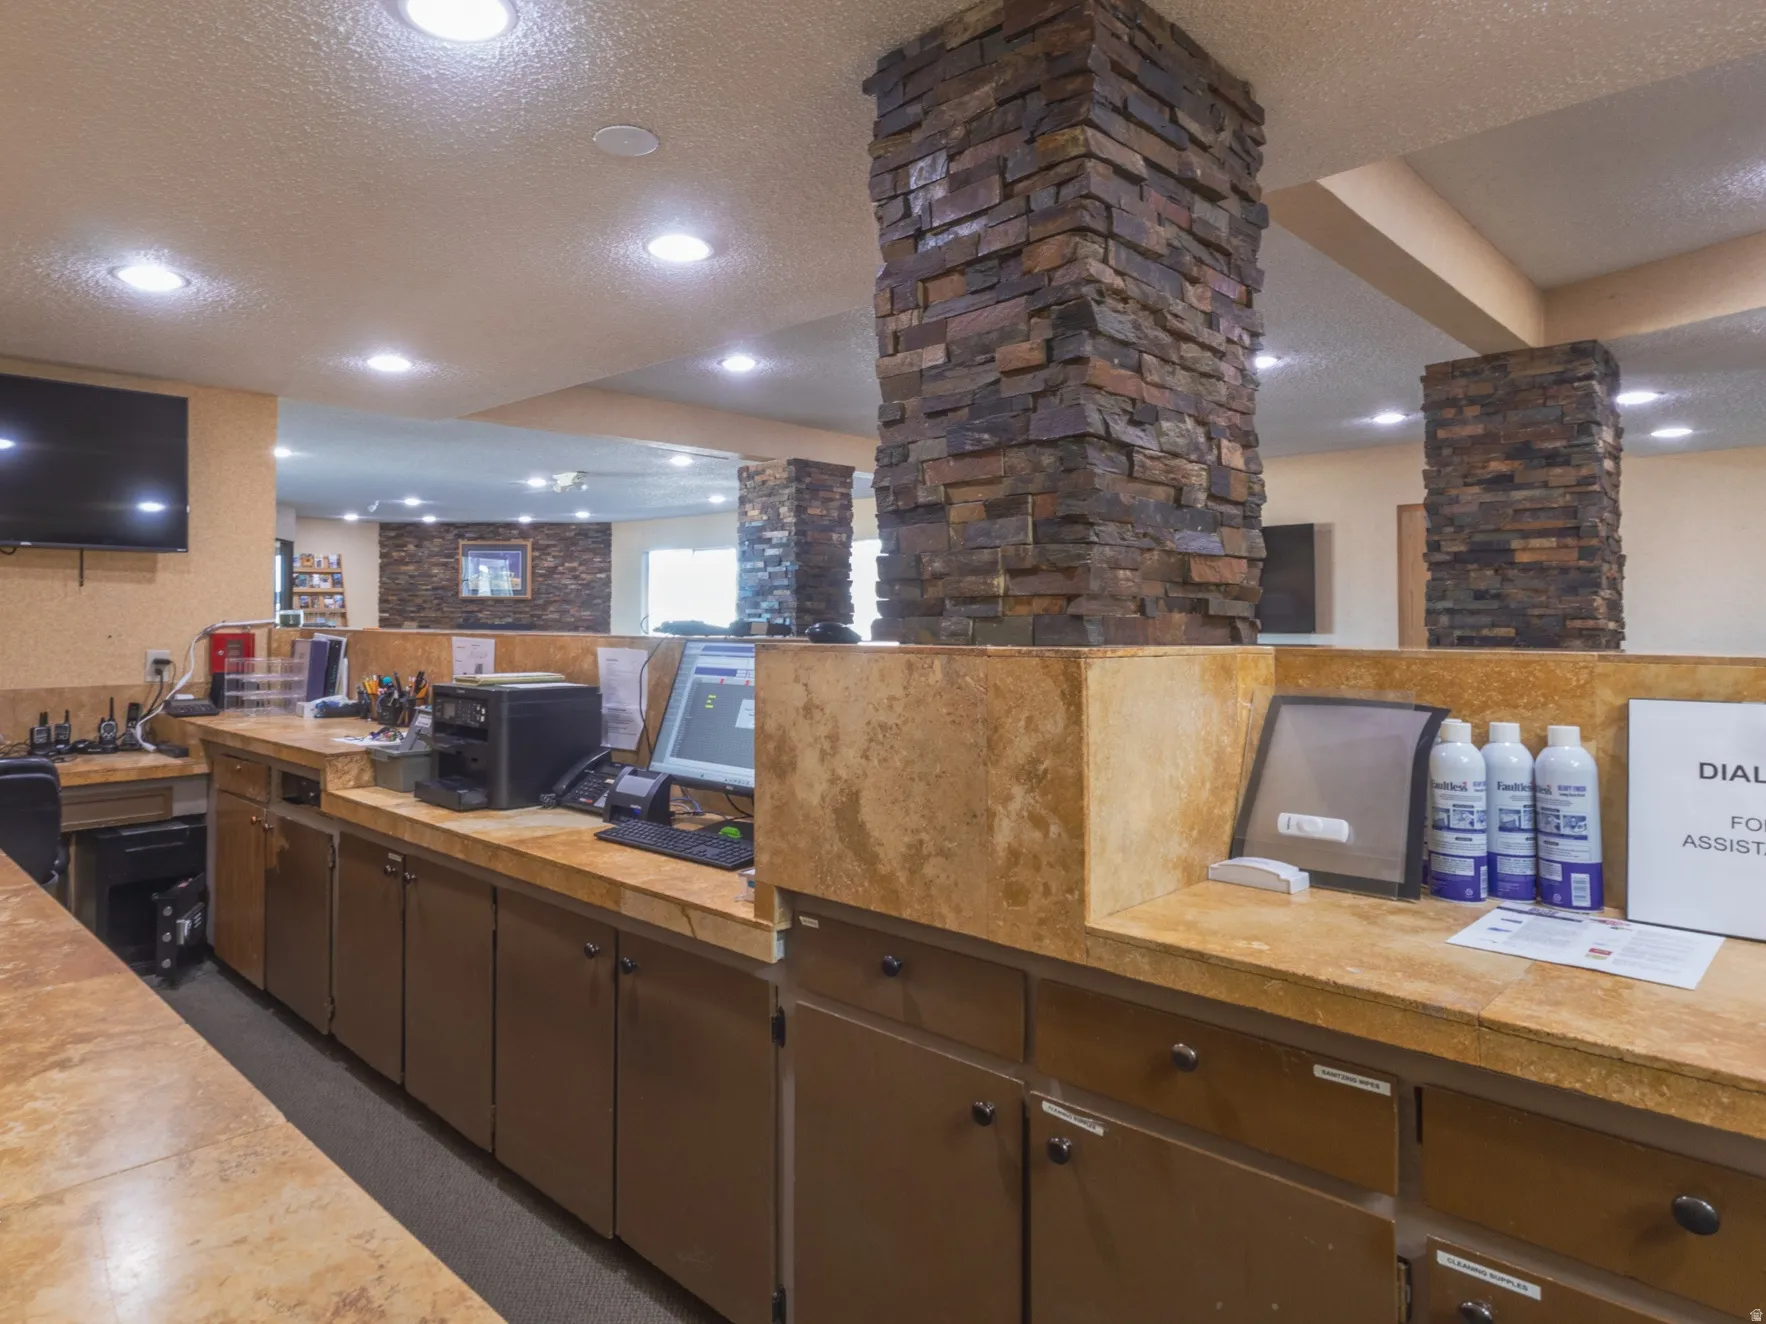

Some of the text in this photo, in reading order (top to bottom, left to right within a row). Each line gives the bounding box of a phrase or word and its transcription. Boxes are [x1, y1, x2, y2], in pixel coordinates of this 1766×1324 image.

[1699, 762, 1766, 784] DIAL
[1731, 816, 1766, 833] FO
[1682, 834, 1766, 856] ASSIST
[1447, 1257, 1488, 1277] CLEANING
